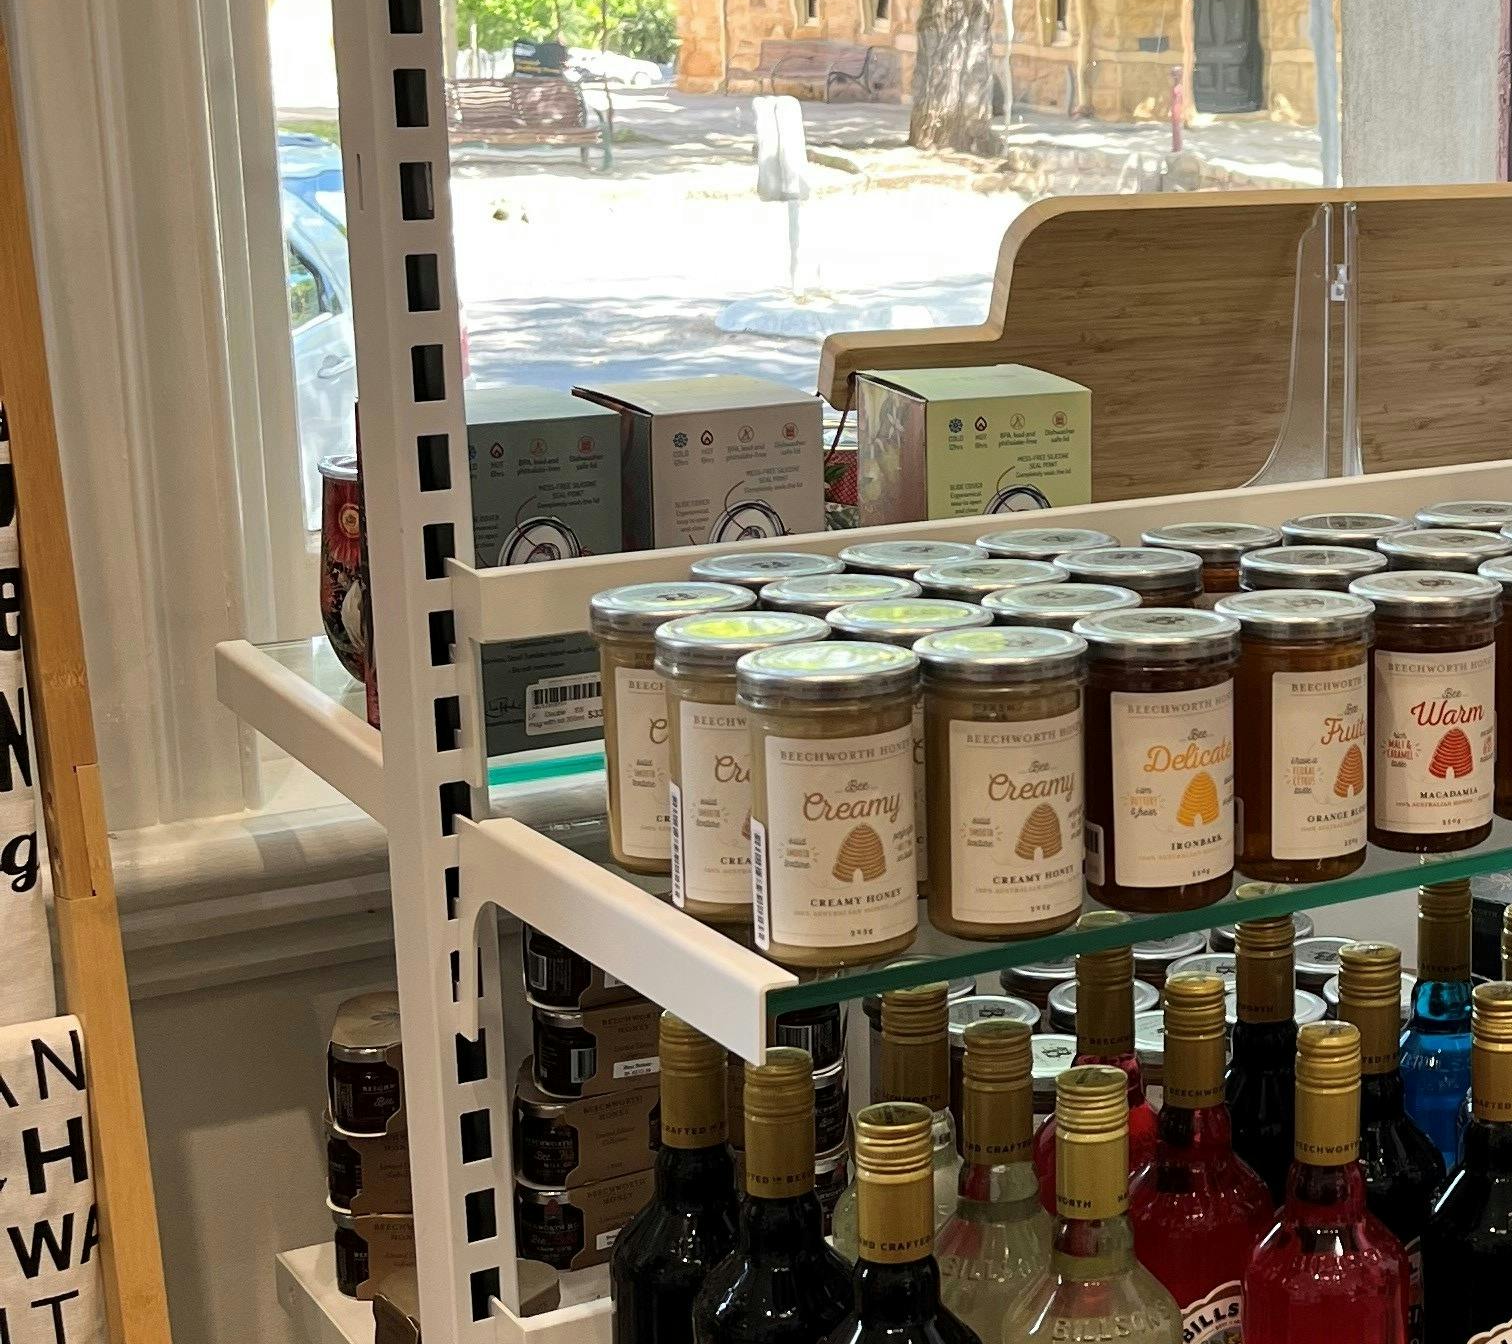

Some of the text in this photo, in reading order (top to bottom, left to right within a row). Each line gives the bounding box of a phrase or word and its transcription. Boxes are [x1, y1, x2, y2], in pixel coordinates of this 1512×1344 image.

[1388, 662, 1467, 674] BEECHWORTH
[1291, 678, 1363, 693] BEECHWORTH
[1127, 698, 1213, 715] BEECHWORTH
[1410, 699, 1483, 727] Warm
[967, 729, 1056, 744] BEECHWORTH
[781, 747, 875, 763] BEECHWORTH
[988, 772, 1075, 803] Creamy
[1419, 786, 1478, 800] MACADAMIA
[803, 792, 901, 824] Creamy
[1307, 811, 1348, 824] ORANGE
[1171, 834, 1223, 851] IRONBARK
[992, 864, 1074, 885] CREAMY HONEY
[810, 887, 902, 908] CREAMY HONEY
[1183, 1301, 1240, 1344] BILLS
